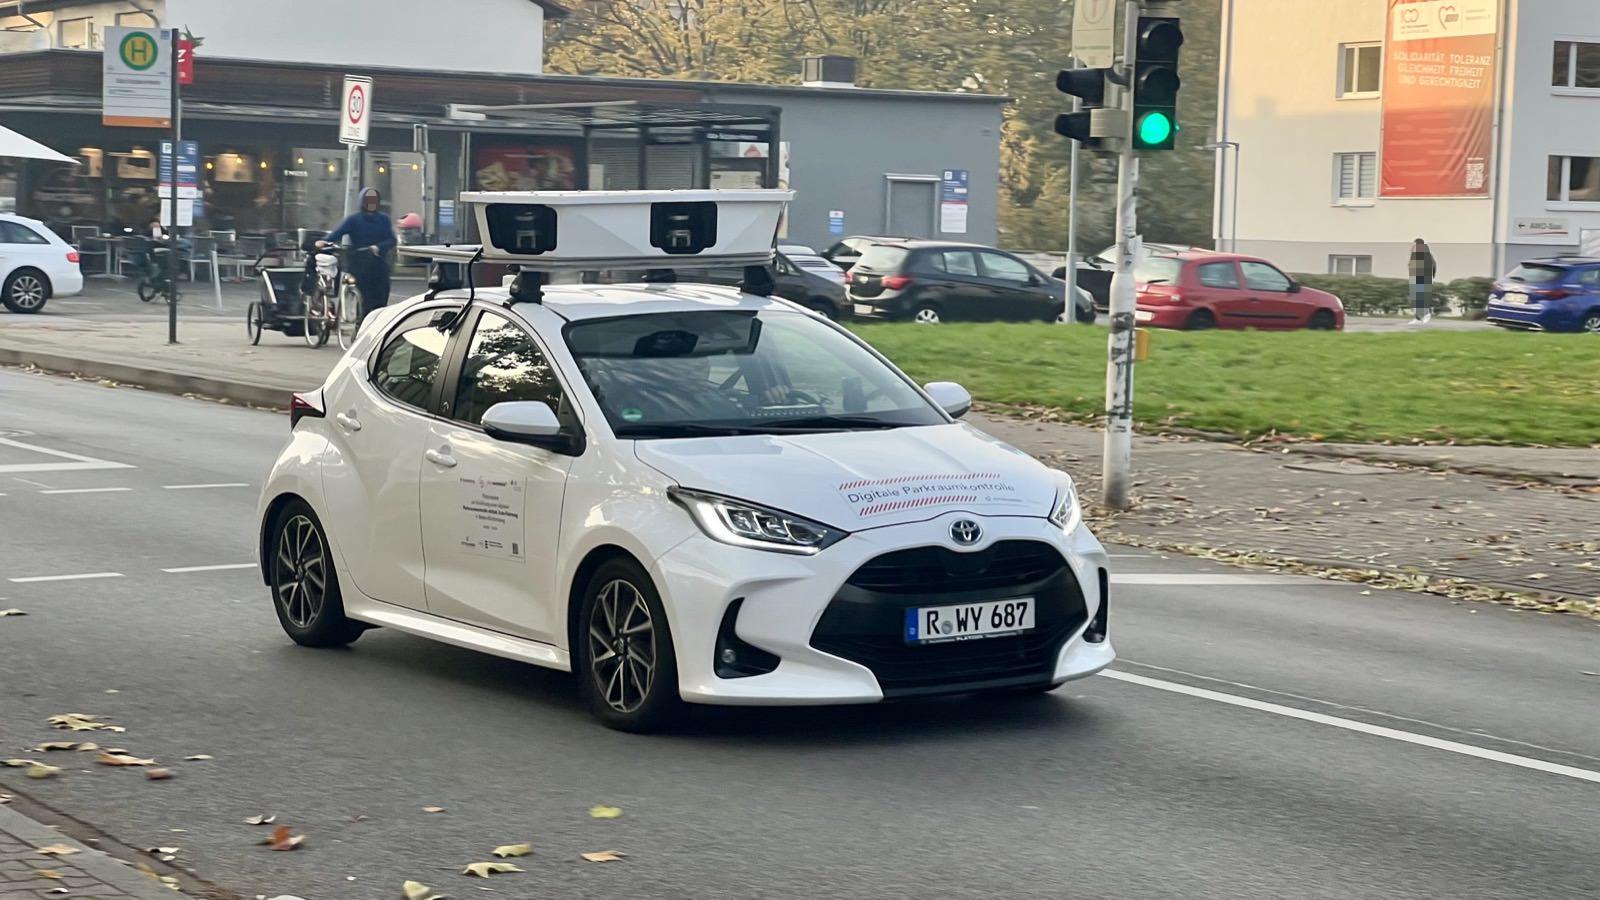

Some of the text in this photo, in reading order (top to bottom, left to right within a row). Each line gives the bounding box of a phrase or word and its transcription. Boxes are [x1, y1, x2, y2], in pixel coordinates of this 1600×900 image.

[131, 40, 147, 62] H
[351, 95, 361, 113] 30
[847, 482, 1015, 503] Digitale Parkraumkontrolle
[926, 601, 1028, 635] R WY 687
